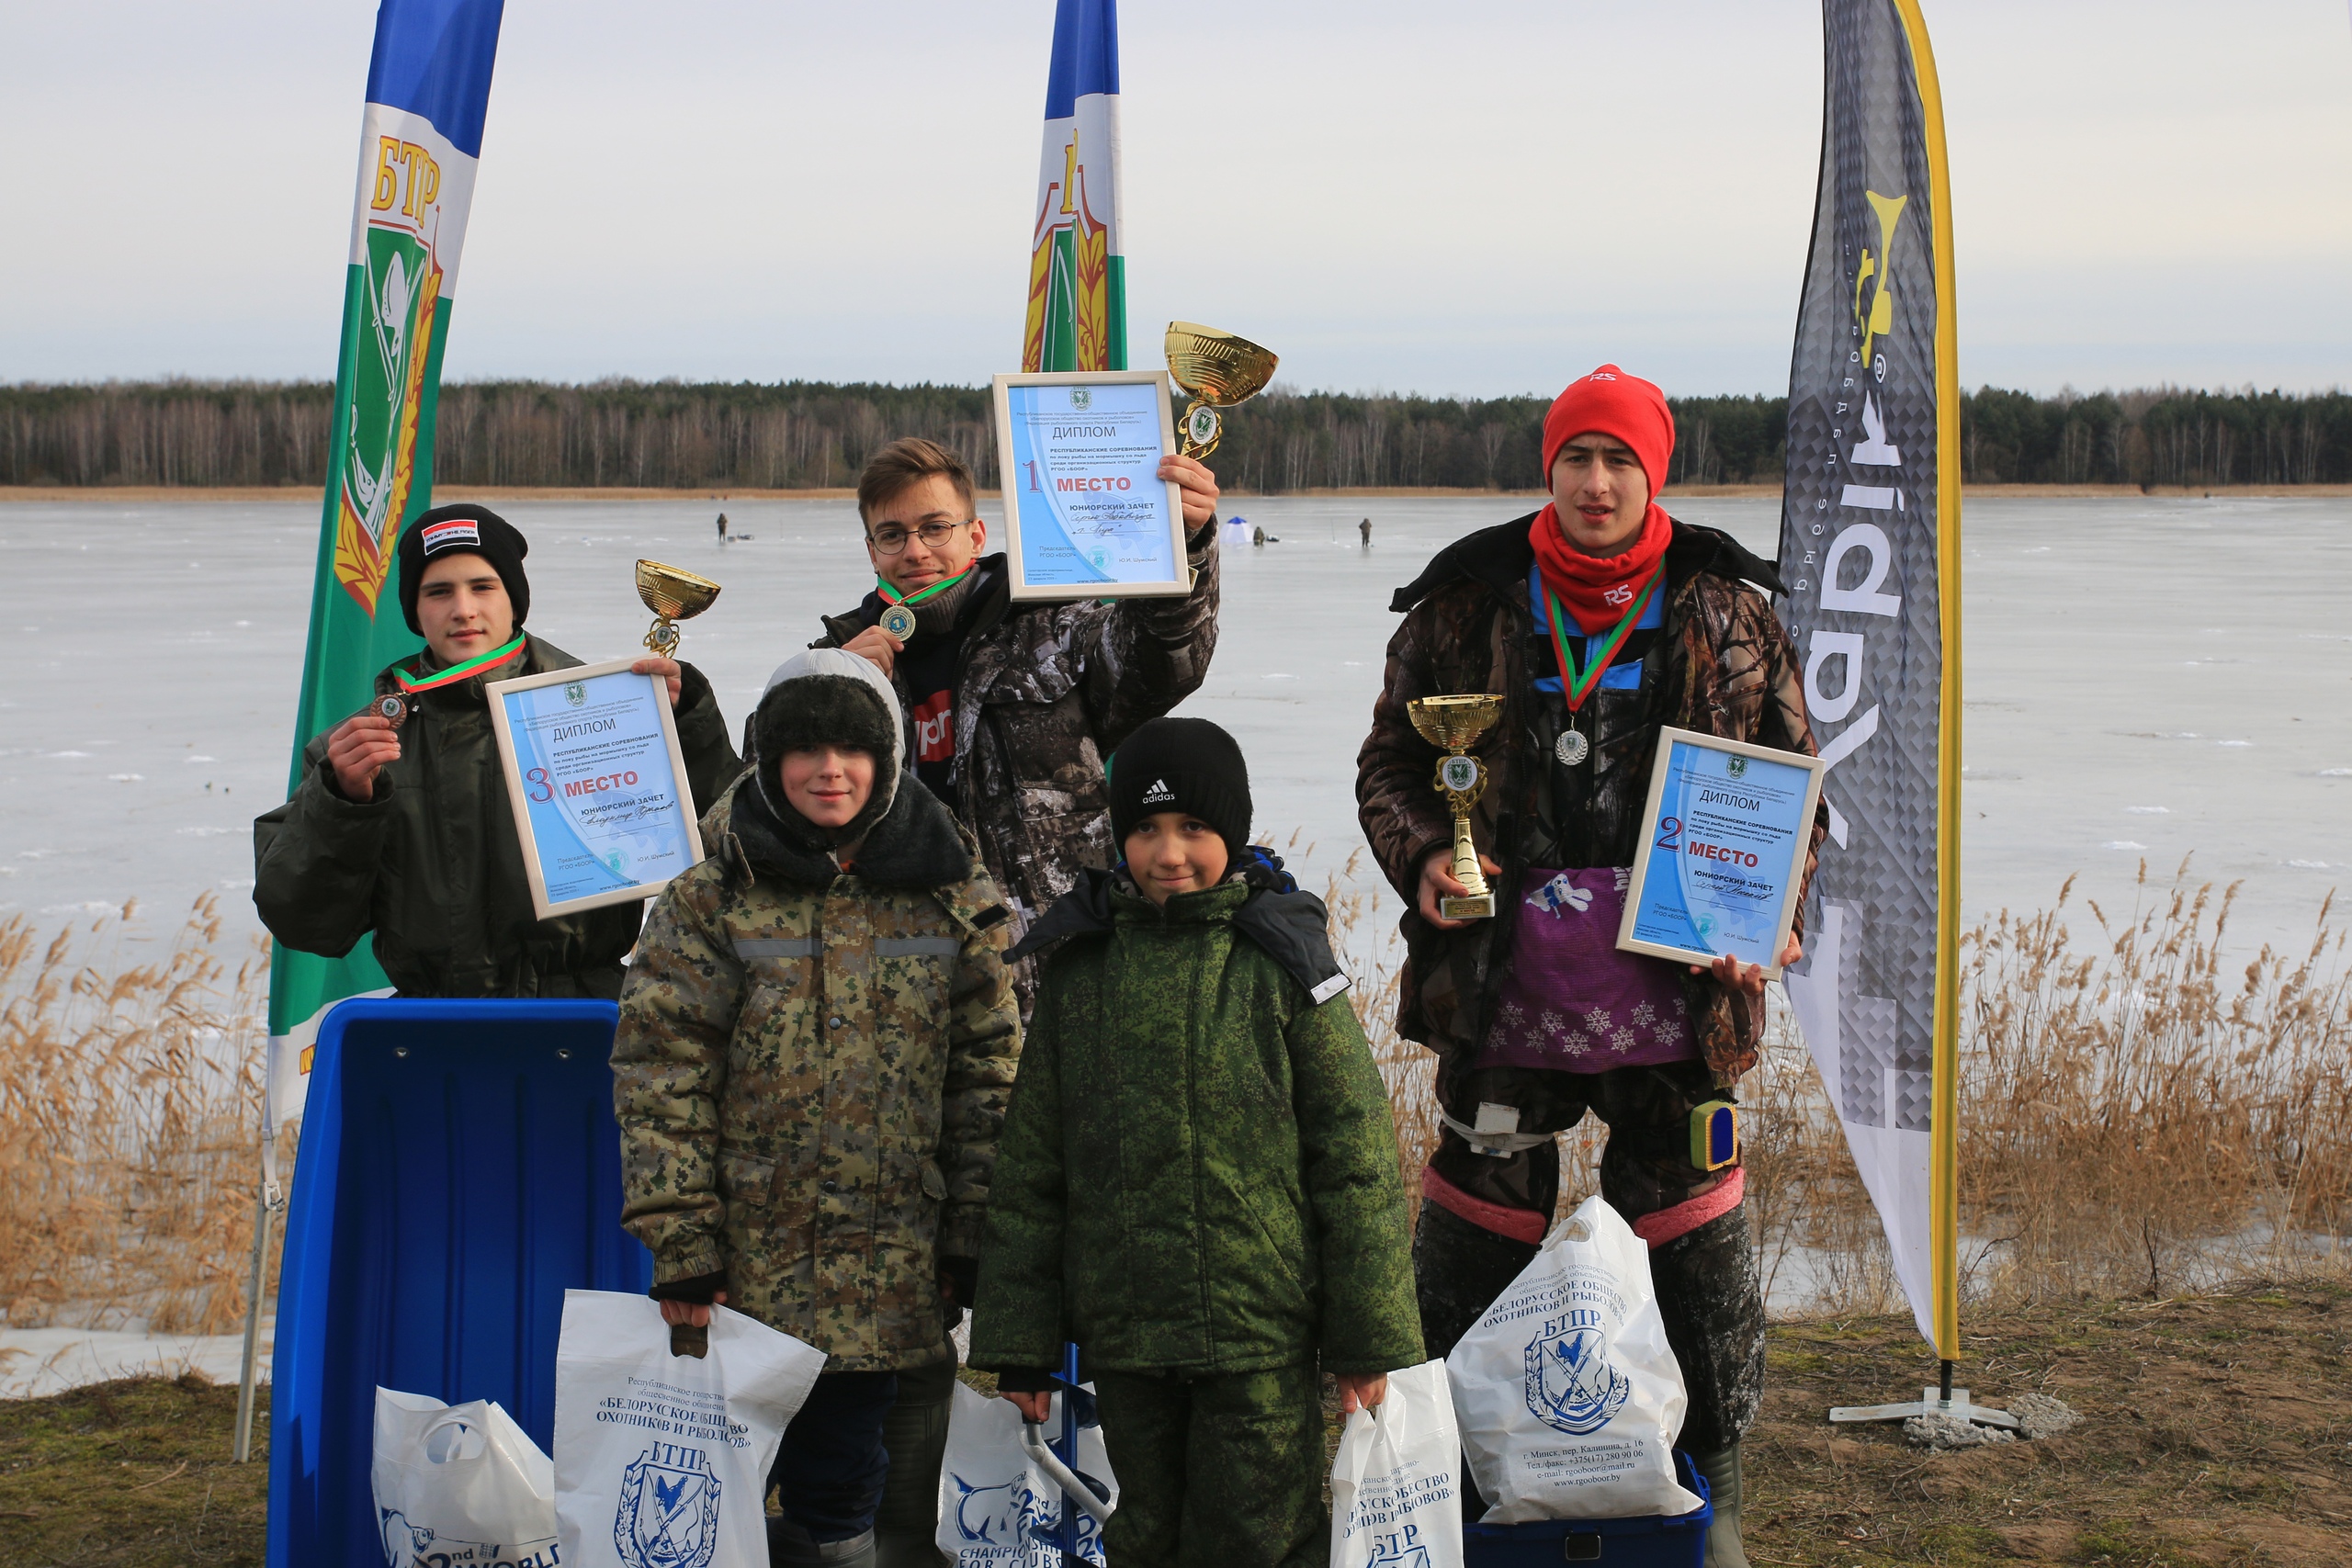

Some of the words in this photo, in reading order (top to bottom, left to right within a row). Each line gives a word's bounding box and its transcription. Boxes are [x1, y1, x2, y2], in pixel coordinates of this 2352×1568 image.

[1589, 372, 1617, 382] RS
[1051, 426, 1115, 439] ДИПЛОМ
[1022, 460, 1041, 492] 1
[1057, 477, 1131, 491] МЕСТО
[1603, 583, 1633, 606] RS
[892, 618, 901, 628] 1
[550, 717, 616, 742] ДИПЛОМ
[552, 742, 610, 757] РЕСПУБЛИКАНСКИЕ
[611, 733, 658, 746] СОРЕВНОВАНИЯ
[599, 747, 628, 755] мормышку
[571, 755, 620, 768] организационных
[524, 765, 558, 806] 3
[564, 770, 639, 797] МЕСТО
[581, 799, 635, 815] ЮНИОРСКИЙ
[637, 794, 664, 805] ЗАЧЕТ
[1142, 793, 1176, 804] adidas
[1699, 789, 1760, 813] ДИПЛОМ
[1692, 810, 1747, 825] РЕСПУБЛИКАНСКИЕ
[1747, 821, 1792, 835] СОРЕВНОВАНИЯ
[1733, 826, 1759, 835] мормышку
[1655, 815, 1686, 852] 2
[1688, 840, 1758, 868] МЕСТО
[1702, 831, 1722, 840] «БООР»
[1705, 827, 1750, 840] организационных
[1751, 836, 1773, 844] структур
[557, 852, 594, 863] Председатель
[574, 859, 594, 867] «БООР»
[1694, 869, 1745, 886] ЮНИОРСКИЙ
[1747, 880, 1773, 891] ЗАЧЕТ
[1654, 903, 1688, 915] Председатель
[1487, 1280, 1579, 1316] «БЕЛОРУССКОЕ
[1582, 1280, 1628, 1314] ОБЩЕСТВО
[1484, 1302, 1560, 1328] ОХОТНИКОВ
[1562, 1296, 1569, 1305] И
[1544, 1309, 1601, 1337] БТПР
[673, 1423, 684, 1435] И
[650, 1440, 707, 1471] БТПР
[1526, 1459, 1566, 1470] Тел./факс:
[1568, 1454, 1604, 1465] +375(17)
[1605, 1452, 1620, 1461] 280
[1622, 1450, 1632, 1459] 90
[1634, 1450, 1644, 1458] 06
[1531, 1450, 1561, 1460] Минск,
[1562, 1449, 1578, 1457] пер.
[1580, 1443, 1623, 1454] Калинина,
[1536, 1469, 1564, 1479] e-mail:
[1566, 1461, 1635, 1477] rgooboor@mail.ru
[1554, 1473, 1621, 1487] www.rgooboor.by
